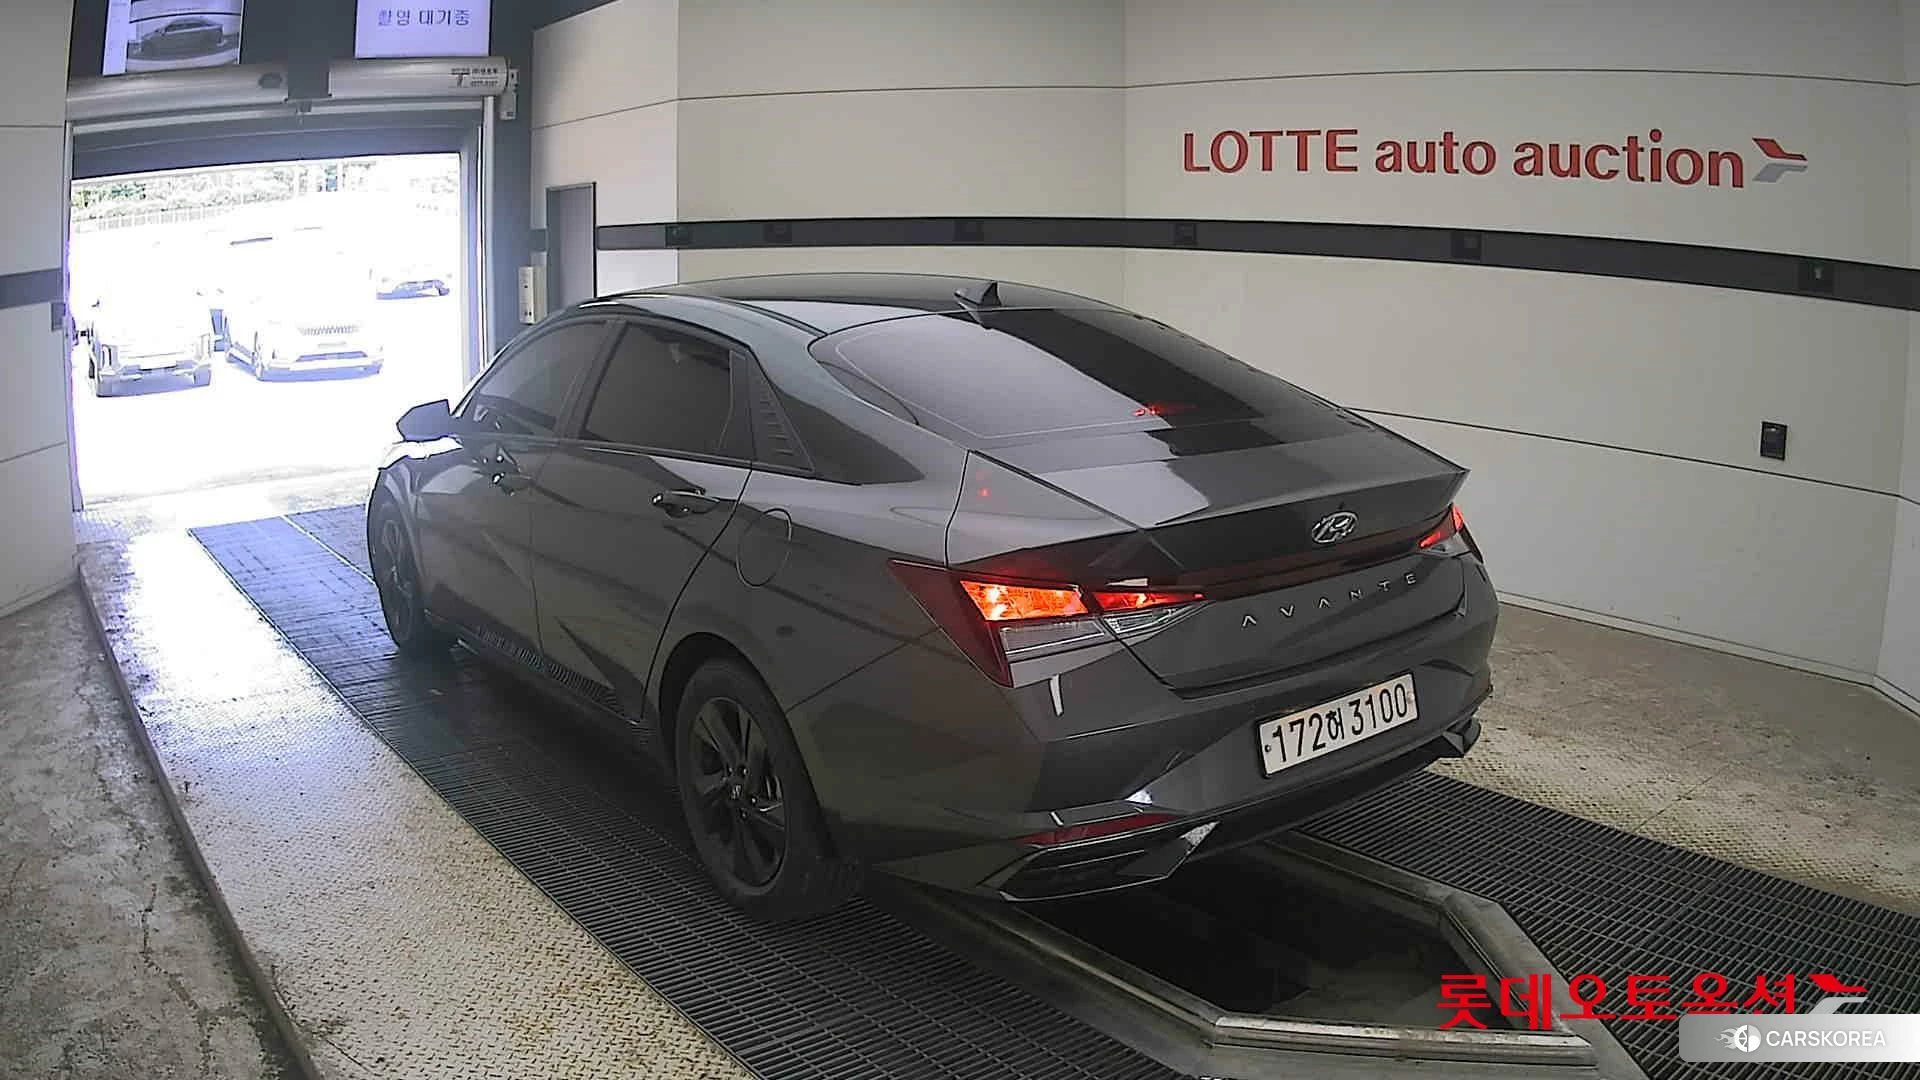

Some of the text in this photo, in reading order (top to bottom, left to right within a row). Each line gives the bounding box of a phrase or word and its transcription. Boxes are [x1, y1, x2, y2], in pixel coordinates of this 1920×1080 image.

[419, 9, 469, 26] 대기중
[1183, 128, 1745, 189] LOTTE auto auction
[1240, 572, 1418, 628] AVANTE
